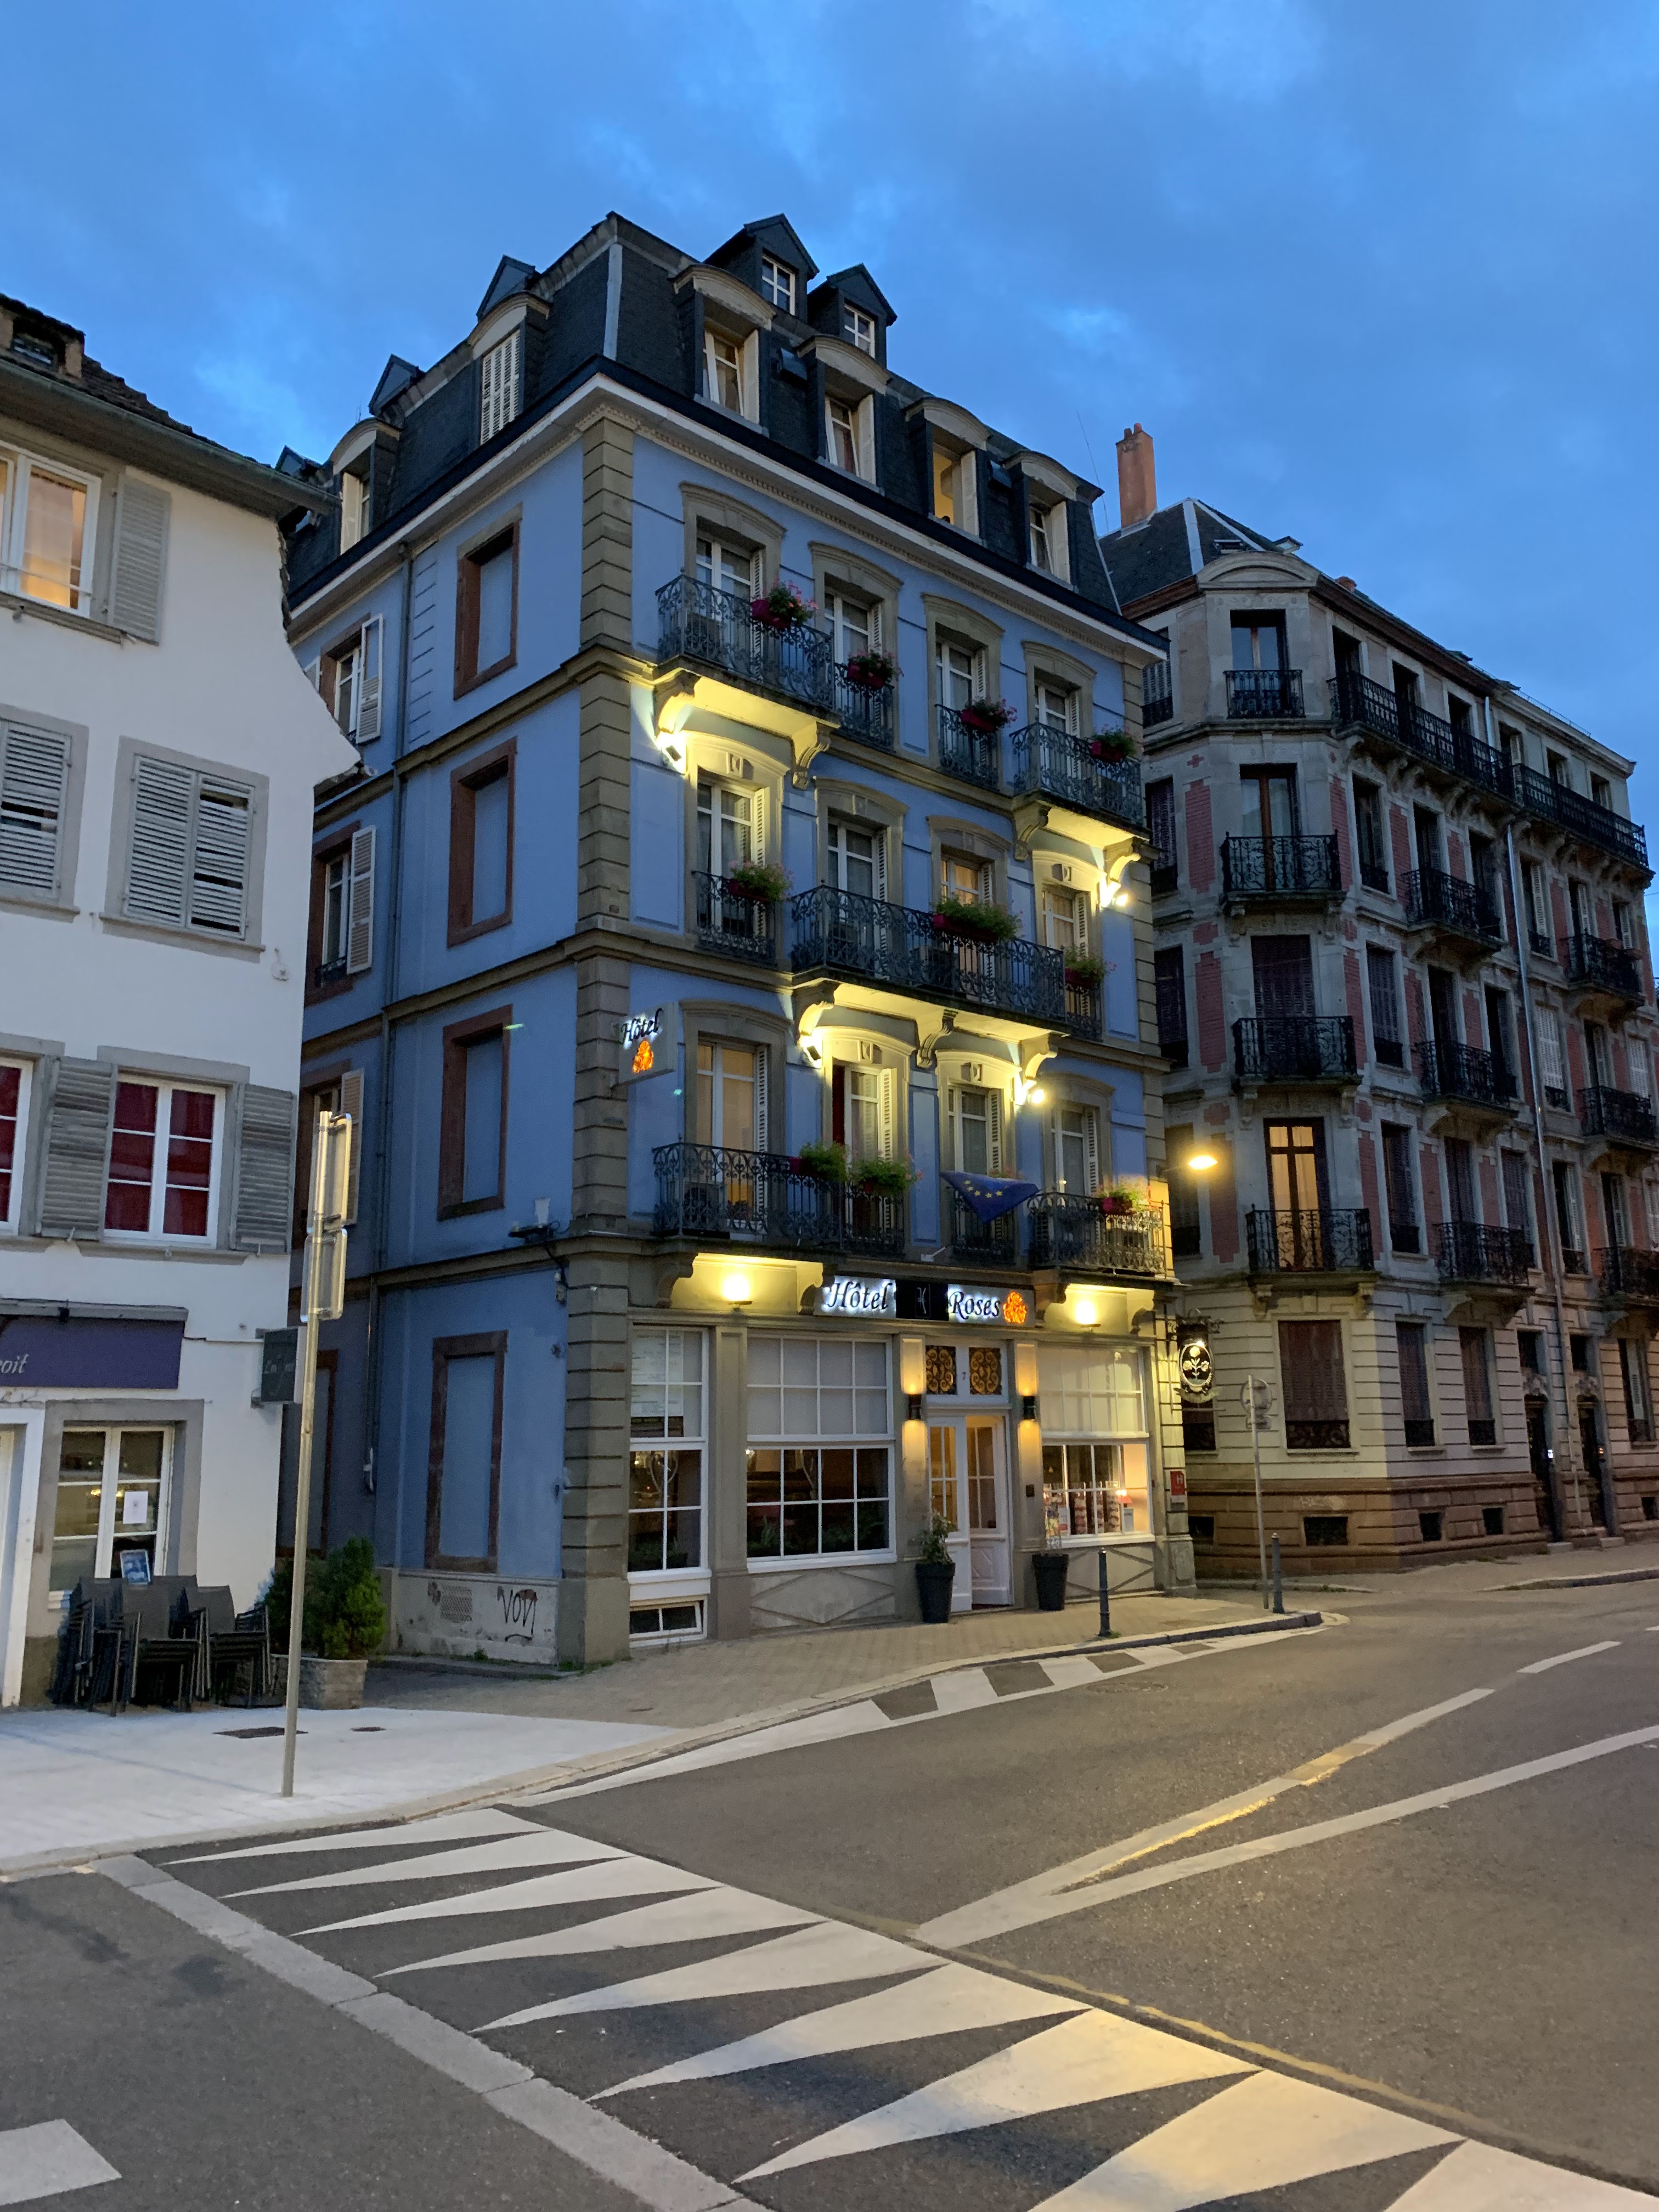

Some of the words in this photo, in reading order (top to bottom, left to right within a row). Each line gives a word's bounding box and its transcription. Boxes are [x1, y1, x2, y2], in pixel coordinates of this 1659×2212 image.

[621, 1007, 664, 1045] Hôtel
[827, 1281, 893, 1310] Hôtel
[949, 1291, 1001, 1320] Roses
[0, 1353, 29, 1374] oit
[962, 1372, 967, 1381] 7
[1176, 1474, 1183, 1485] H
